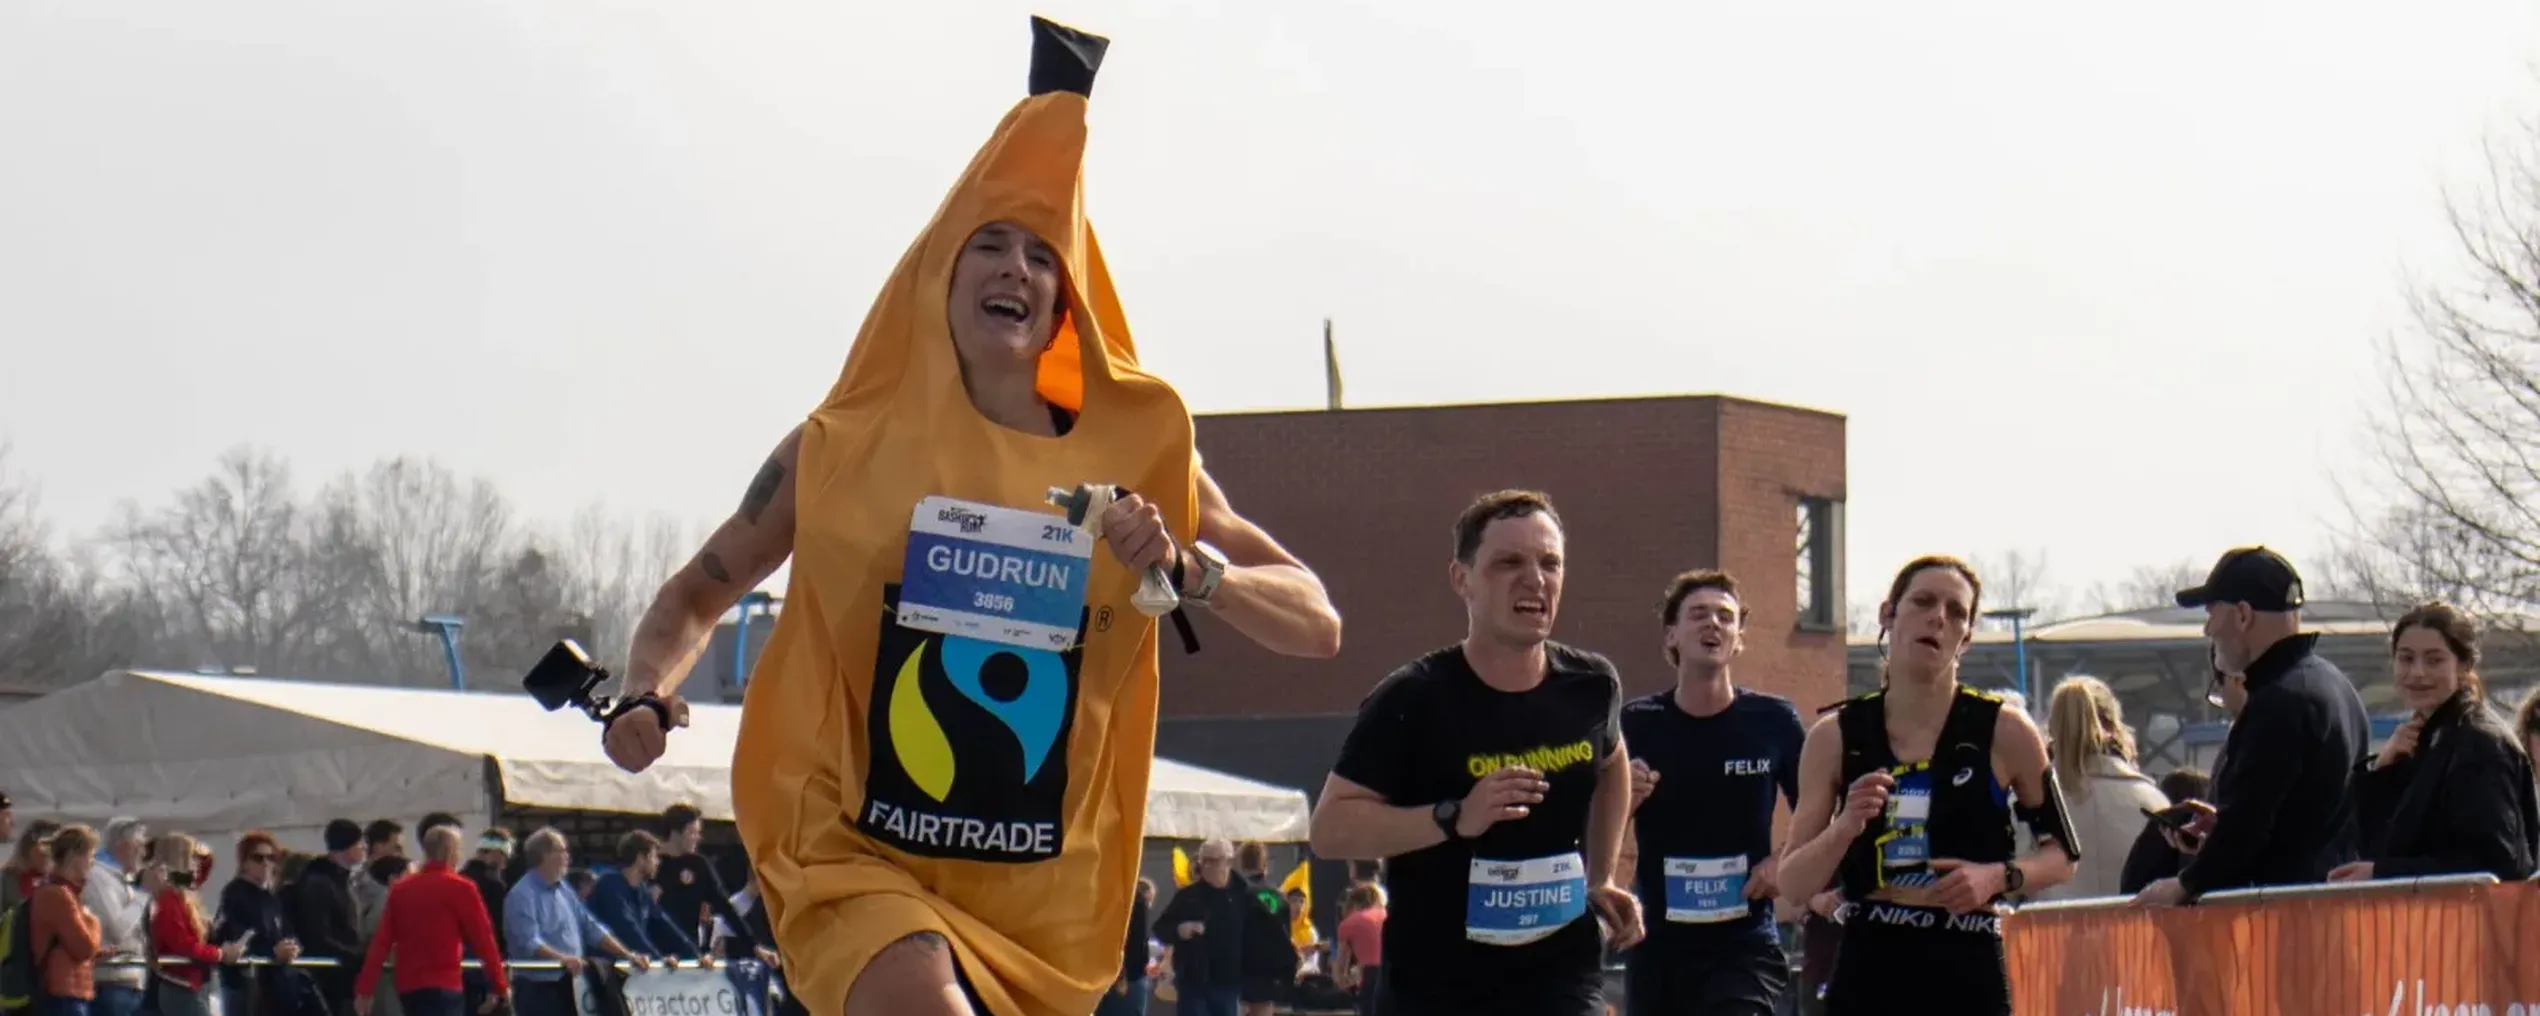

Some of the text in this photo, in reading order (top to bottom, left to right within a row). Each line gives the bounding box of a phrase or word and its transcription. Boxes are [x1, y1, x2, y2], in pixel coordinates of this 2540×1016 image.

[1041, 525, 1073, 543] 21K
[927, 545, 1069, 590] GUDRUN
[973, 591, 1015, 612] 3856
[1724, 758, 1771, 776] FELIX
[868, 800, 1055, 854] FAIRTRADE
[1483, 885, 1573, 908] JUSTINE
[1685, 878, 1728, 895] FELIX
[1945, 914, 2001, 933] NIKE
